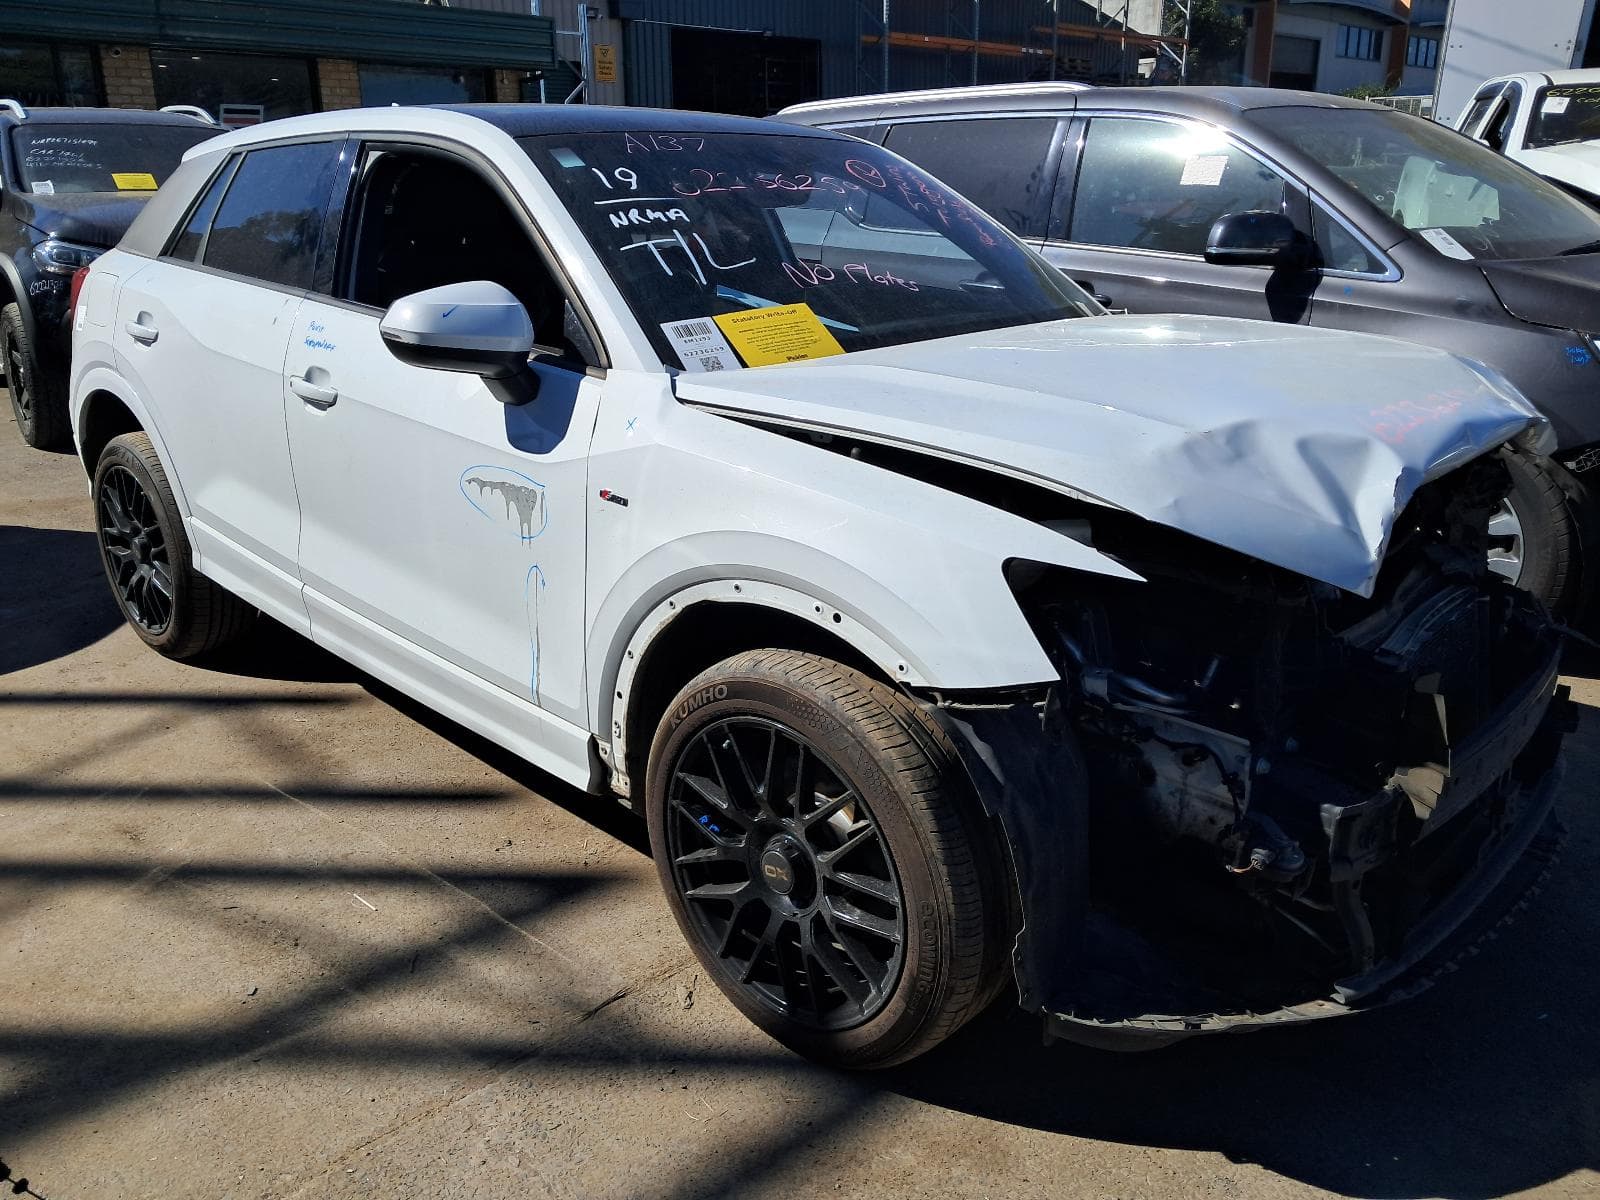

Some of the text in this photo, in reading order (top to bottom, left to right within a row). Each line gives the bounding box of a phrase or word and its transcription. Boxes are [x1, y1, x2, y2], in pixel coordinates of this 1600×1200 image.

[625, 132, 705, 153] A137
[592, 167, 638, 190] 19
[608, 208, 690, 228] NRMA
[843, 262, 920, 292] Plates
[731, 309, 798, 323] Statutory Write-Off
[670, 684, 728, 730] KUMHO
[917, 900, 939, 994] ecowing
